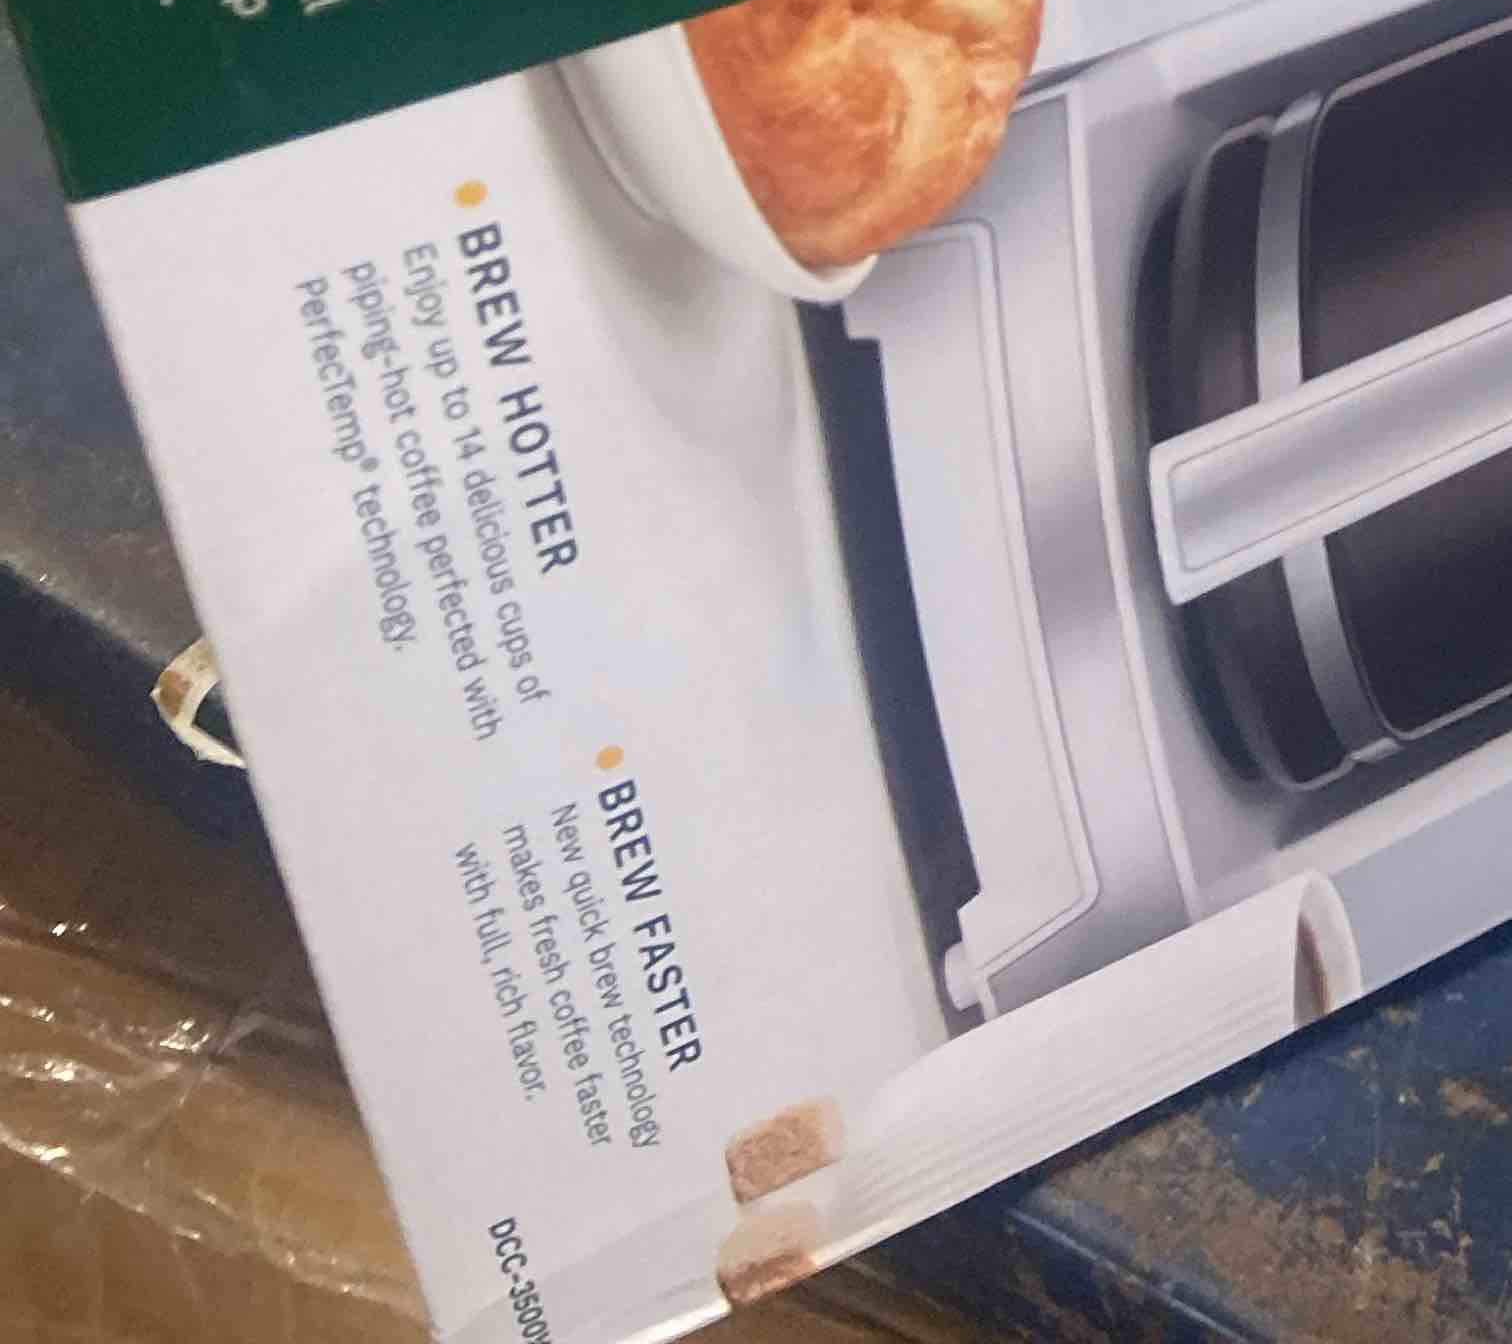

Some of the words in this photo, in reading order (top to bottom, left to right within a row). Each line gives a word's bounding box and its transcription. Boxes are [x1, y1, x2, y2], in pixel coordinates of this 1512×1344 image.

[403, 242, 448, 328] Enjoy
[339, 261, 417, 425] piping-hot
[424, 338, 458, 379] up
[441, 386, 471, 421] to
[457, 221, 532, 368] BREW
[499, 384, 579, 575] HOTTER
[396, 428, 443, 529] coffee
[453, 426, 486, 461] 14
[352, 482, 416, 652] technology.
[463, 469, 516, 596] delicious
[414, 532, 488, 673] perfected
[496, 600, 534, 670] cups
[463, 676, 503, 742] with
[516, 674, 552, 704] of
[503, 823, 545, 912] makes
[551, 801, 584, 864] New
[455, 842, 497, 905] with
[562, 869, 609, 943] quick
[473, 906, 513, 965] full,
[529, 913, 571, 986] fresh
[597, 779, 662, 902] BREW
[632, 913, 702, 1073] FASTER
[490, 966, 529, 1018] rich
[588, 941, 624, 1009] brew
[507, 1020, 547, 1102] flavor.
[549, 988, 591, 1072] coffee
[575, 1072, 612, 1147] faster
[607, 1012, 661, 1150] technology
